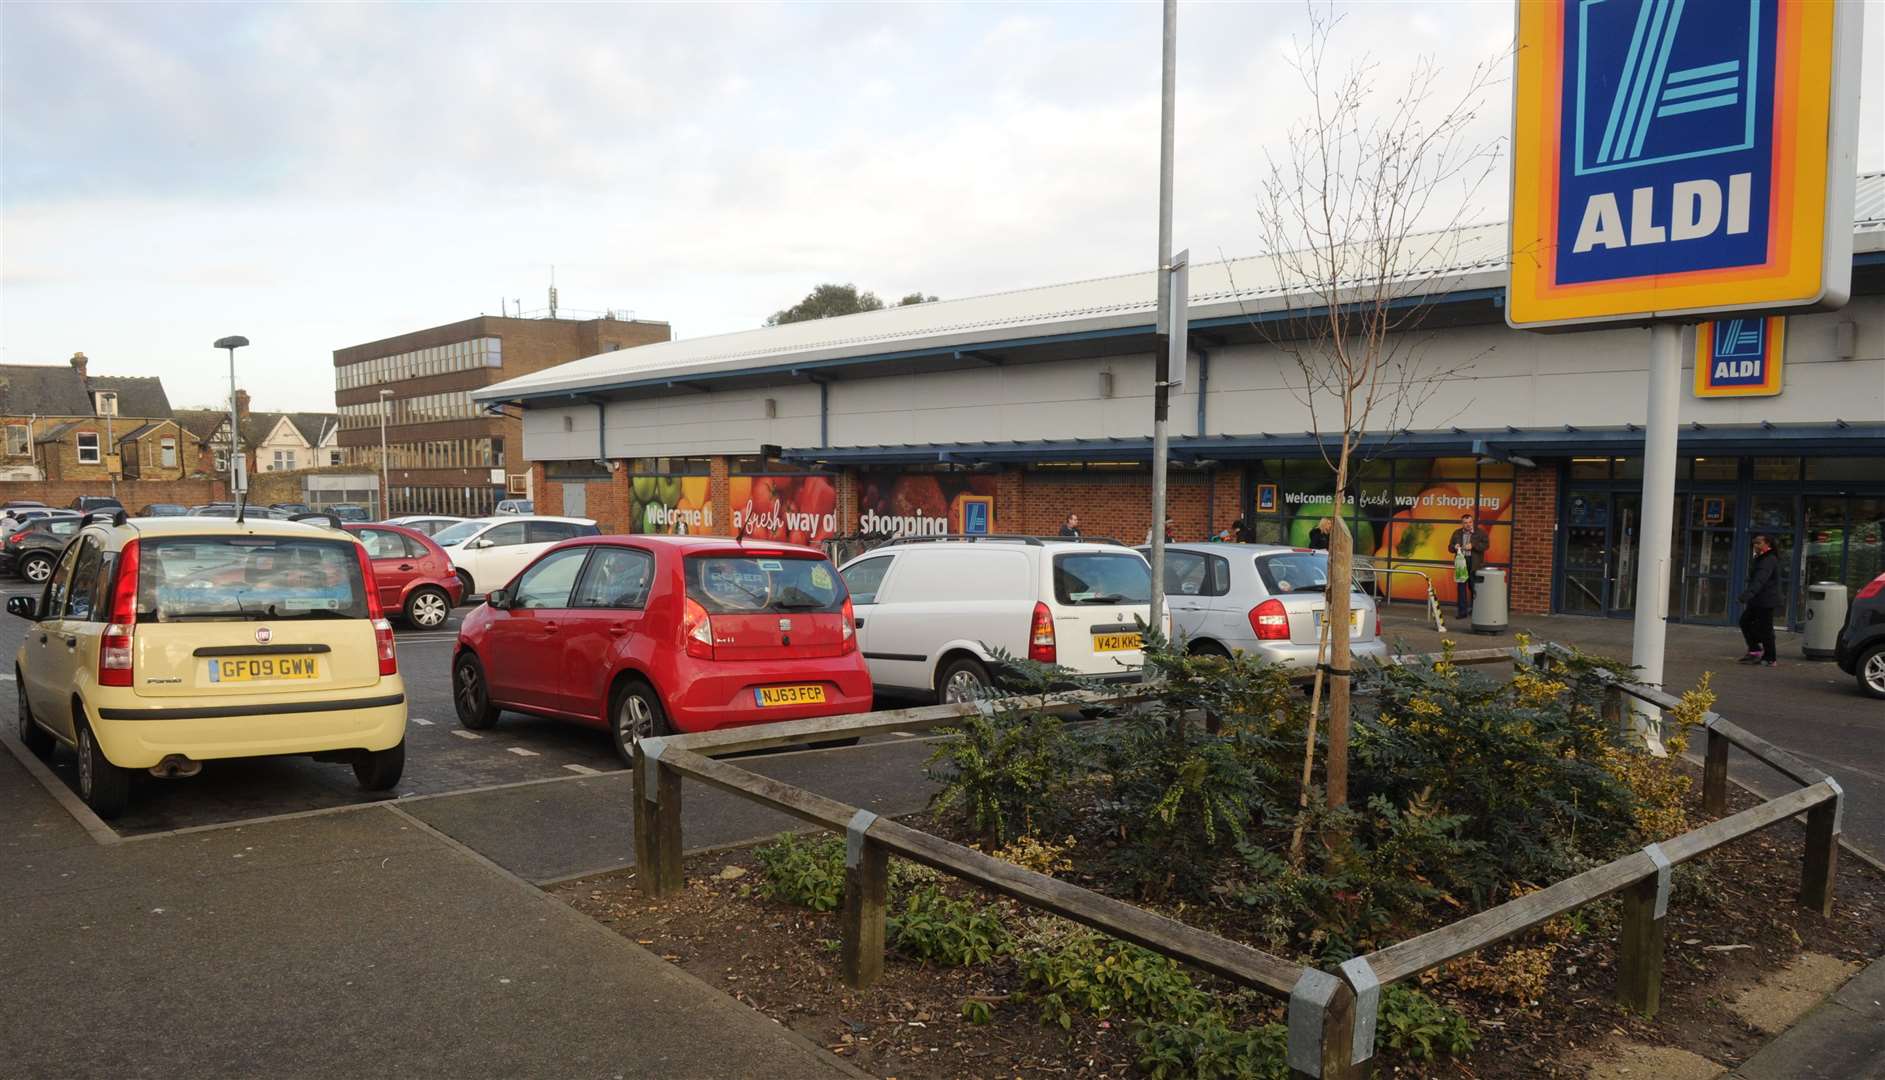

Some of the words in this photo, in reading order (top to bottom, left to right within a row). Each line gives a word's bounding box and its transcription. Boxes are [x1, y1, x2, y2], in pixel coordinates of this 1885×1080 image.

[1573, 172, 1752, 253] ALDI
[1714, 360, 1760, 379] ALDI
[1285, 492, 1333, 504] Welcome
[1347, 495, 1355, 505] a
[1359, 489, 1391, 508] fresh
[1395, 495, 1420, 509] way
[1422, 494, 1435, 506] of
[733, 510, 742, 529] a
[745, 499, 784, 534] fresh
[786, 512, 820, 538] way
[1098, 637, 1120, 649] V421
[223, 660, 274, 678] GF09
[279, 658, 315, 675] GWW
[763, 688, 797, 704] NJ63
[800, 687, 822, 700] FCP
